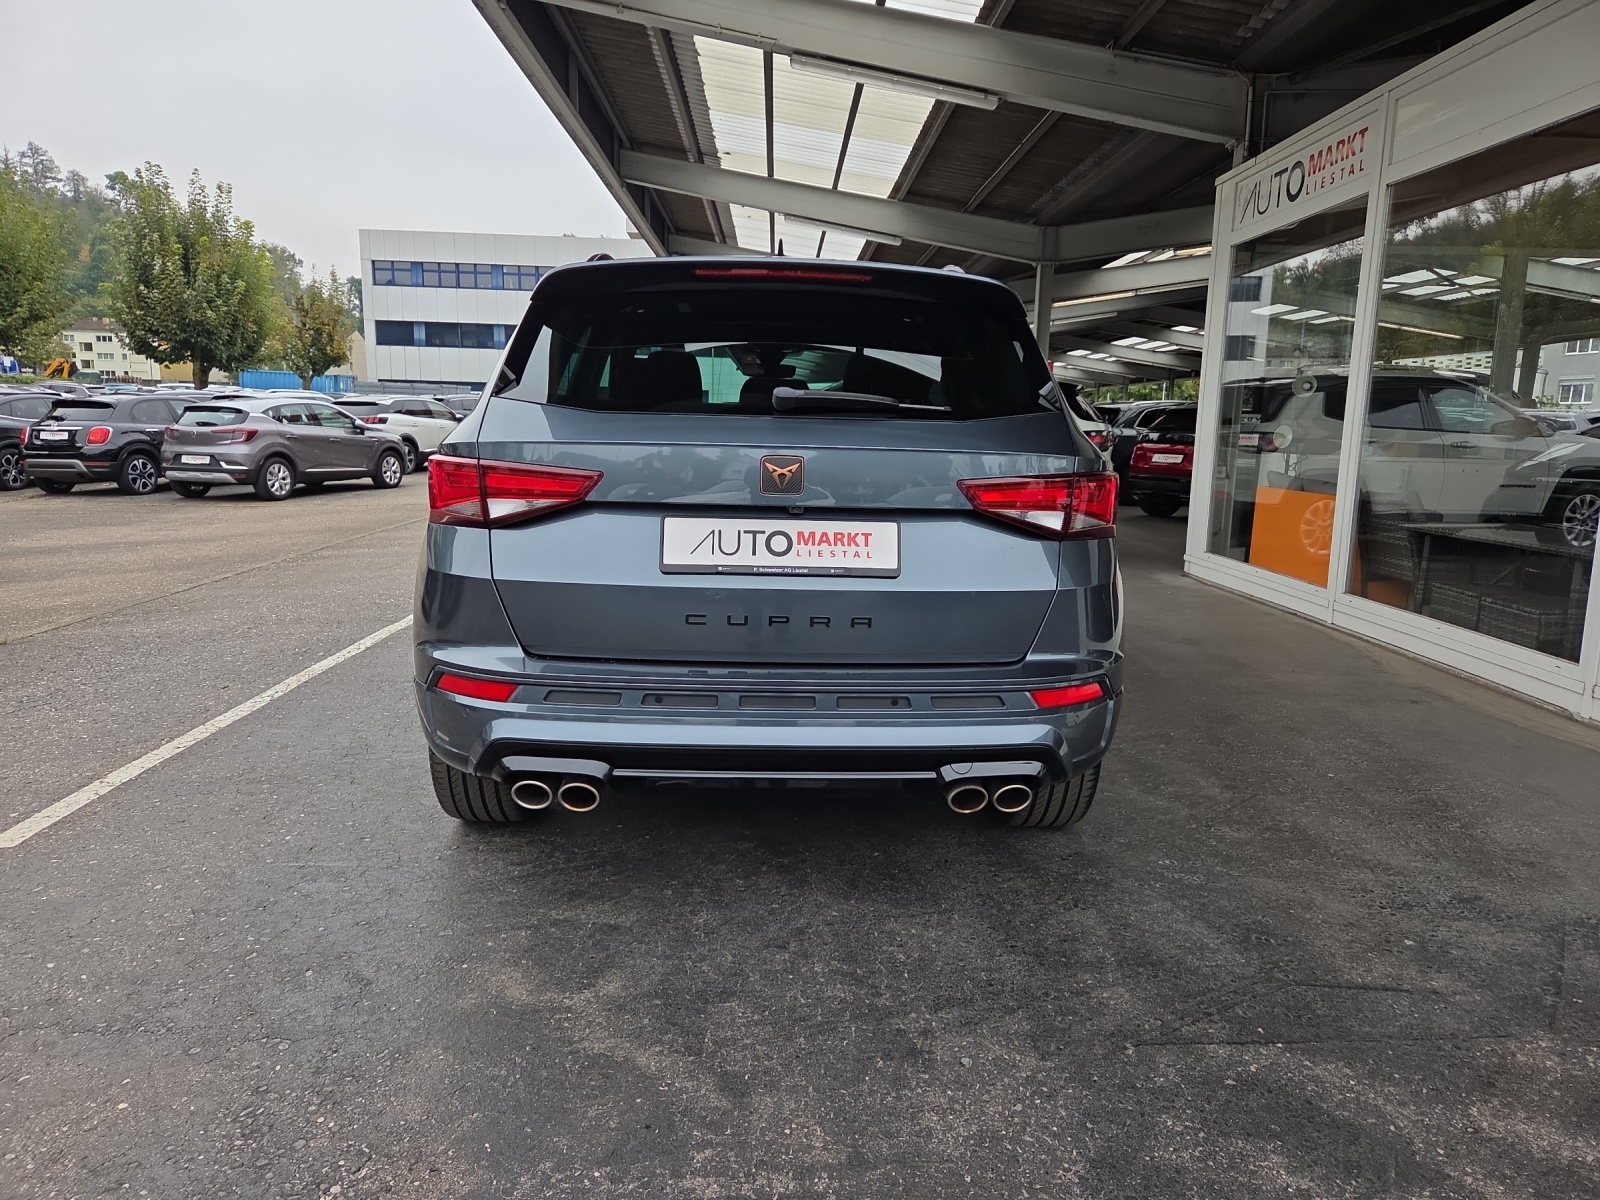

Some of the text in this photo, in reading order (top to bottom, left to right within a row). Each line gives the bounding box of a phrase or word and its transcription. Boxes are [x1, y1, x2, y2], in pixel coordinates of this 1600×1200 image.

[1239, 126, 1369, 224] AUTO MARKT
[1305, 159, 1365, 196] LIESTAL
[689, 529, 873, 557] AUTO MARKT
[796, 549, 873, 559] LIESTAL
[684, 612, 873, 629] CUPRA
